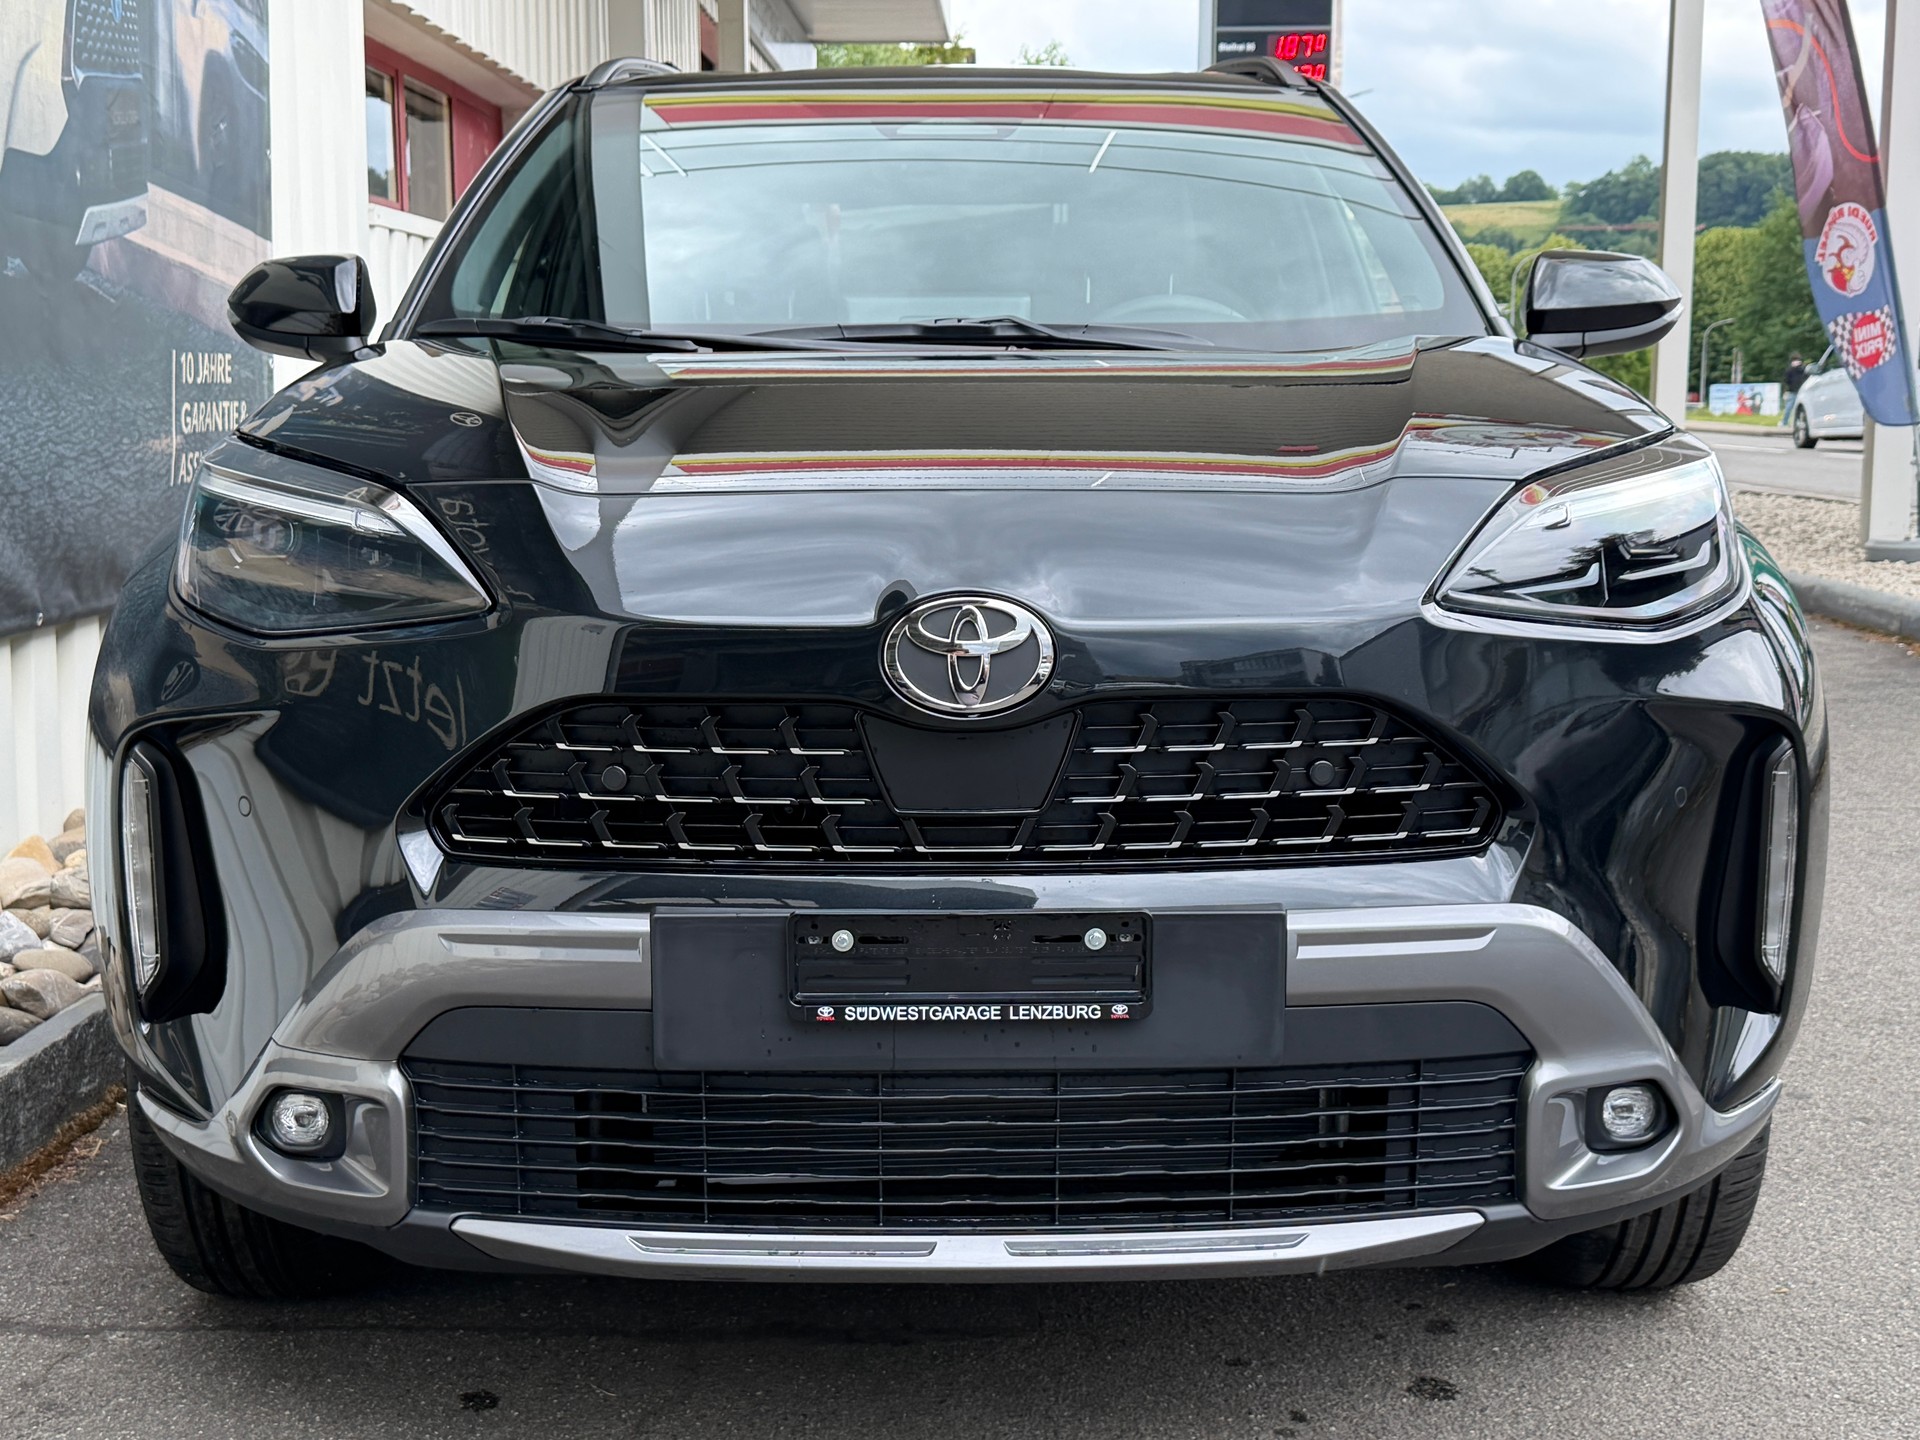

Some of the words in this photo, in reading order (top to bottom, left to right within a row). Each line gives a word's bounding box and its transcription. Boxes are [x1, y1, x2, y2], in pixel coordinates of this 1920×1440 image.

[180, 352, 195, 384] 10
[197, 352, 233, 384] JAHRE
[181, 401, 240, 434] GARANTIE
[844, 1005, 1002, 1021] SÜDWESTGARAGE
[1009, 1004, 1102, 1020] LENZBURG
